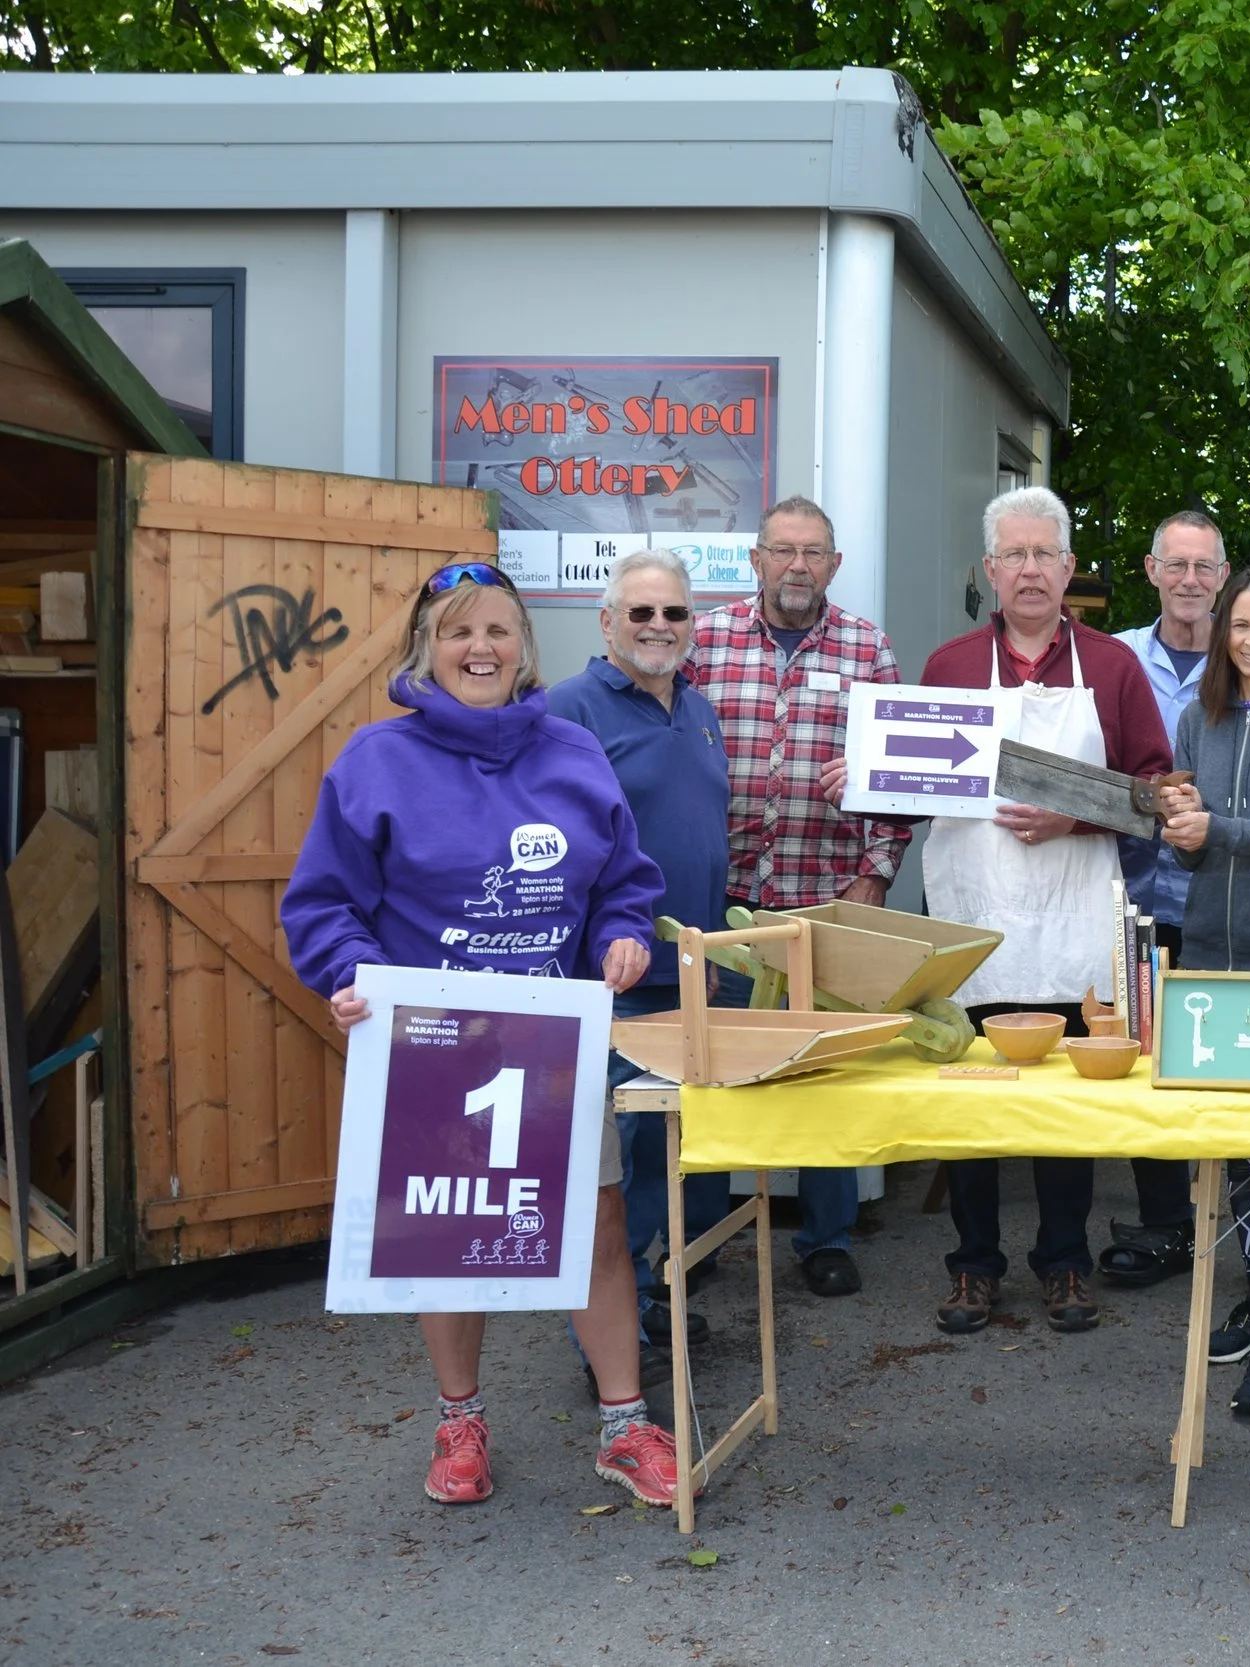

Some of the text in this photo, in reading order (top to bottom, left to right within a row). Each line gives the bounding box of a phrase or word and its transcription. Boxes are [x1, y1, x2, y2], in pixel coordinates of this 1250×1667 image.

[454, 395, 757, 436] Men's Shed
[520, 456, 693, 497] Ottery
[594, 541, 616, 557] Tel:
[707, 545, 751, 563] Ottery Hel
[500, 560, 524, 570] heds
[565, 563, 600, 581] 01404
[707, 564, 739, 580] Scheme
[904, 712, 940, 720] MARATHON
[923, 776, 959, 784] MARATHON
[516, 832, 556, 841] Women
[517, 840, 559, 857] CAN
[549, 876, 564, 885] only
[515, 885, 564, 894] MARATHON
[548, 894, 563, 903] john
[512, 909, 523, 917] 28
[524, 907, 541, 915] MAY
[440, 927, 469, 945] IP
[549, 925, 574, 944] Lt
[467, 945, 560, 954] Business Communic
[1115, 900, 1127, 1003] THE WOODWORK BOOK
[1129, 948, 1137, 987] CRAFTSMAN
[1141, 965, 1150, 994] WOOD
[1130, 987, 1138, 1033] WOODTURNER
[411, 1016, 459, 1028] Women only
[405, 1025, 459, 1036] MARATHON
[410, 1036, 431, 1045] tipton
[441, 1038, 458, 1046] john
[464, 1068, 525, 1169] 1
[405, 1176, 540, 1215] MILE
[513, 1220, 539, 1230] CAN
